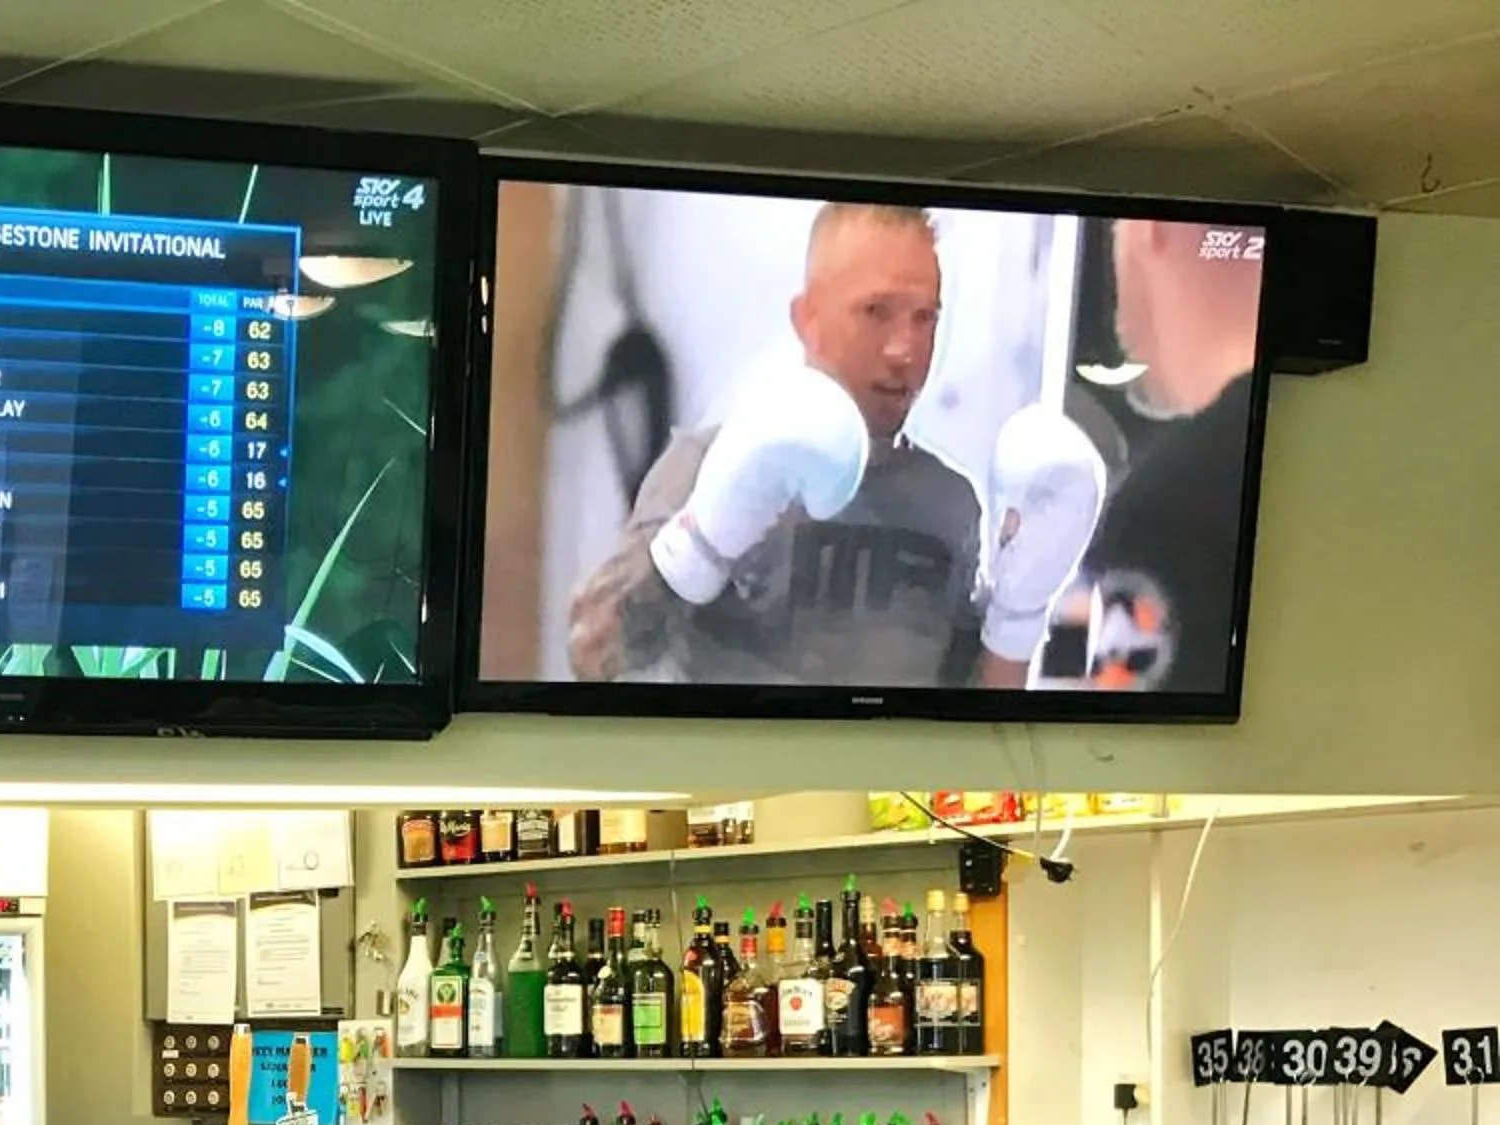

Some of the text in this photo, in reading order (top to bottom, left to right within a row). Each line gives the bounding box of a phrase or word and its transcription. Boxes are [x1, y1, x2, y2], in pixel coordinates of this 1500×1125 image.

[402, 184, 424, 210] 4
[360, 211, 392, 227] LIVE
[89, 231, 226, 260] INVITATIONAL
[1243, 236, 1265, 259] 2
[198, 293, 229, 307] TOTAL
[248, 321, 271, 339] 62
[247, 351, 270, 369] 63
[246, 381, 269, 400] 63
[245, 411, 268, 430] 64
[247, 443, 266, 460] 17
[246, 473, 266, 490] 16
[242, 502, 264, 520] 65
[241, 532, 263, 550] 65
[240, 561, 262, 579] 65
[239, 590, 261, 608] 65
[1198, 1037, 1229, 1079] 35
[1282, 1039, 1328, 1078] 30
[1333, 1035, 1382, 1078] 39
[1451, 1035, 1493, 1077] 31
